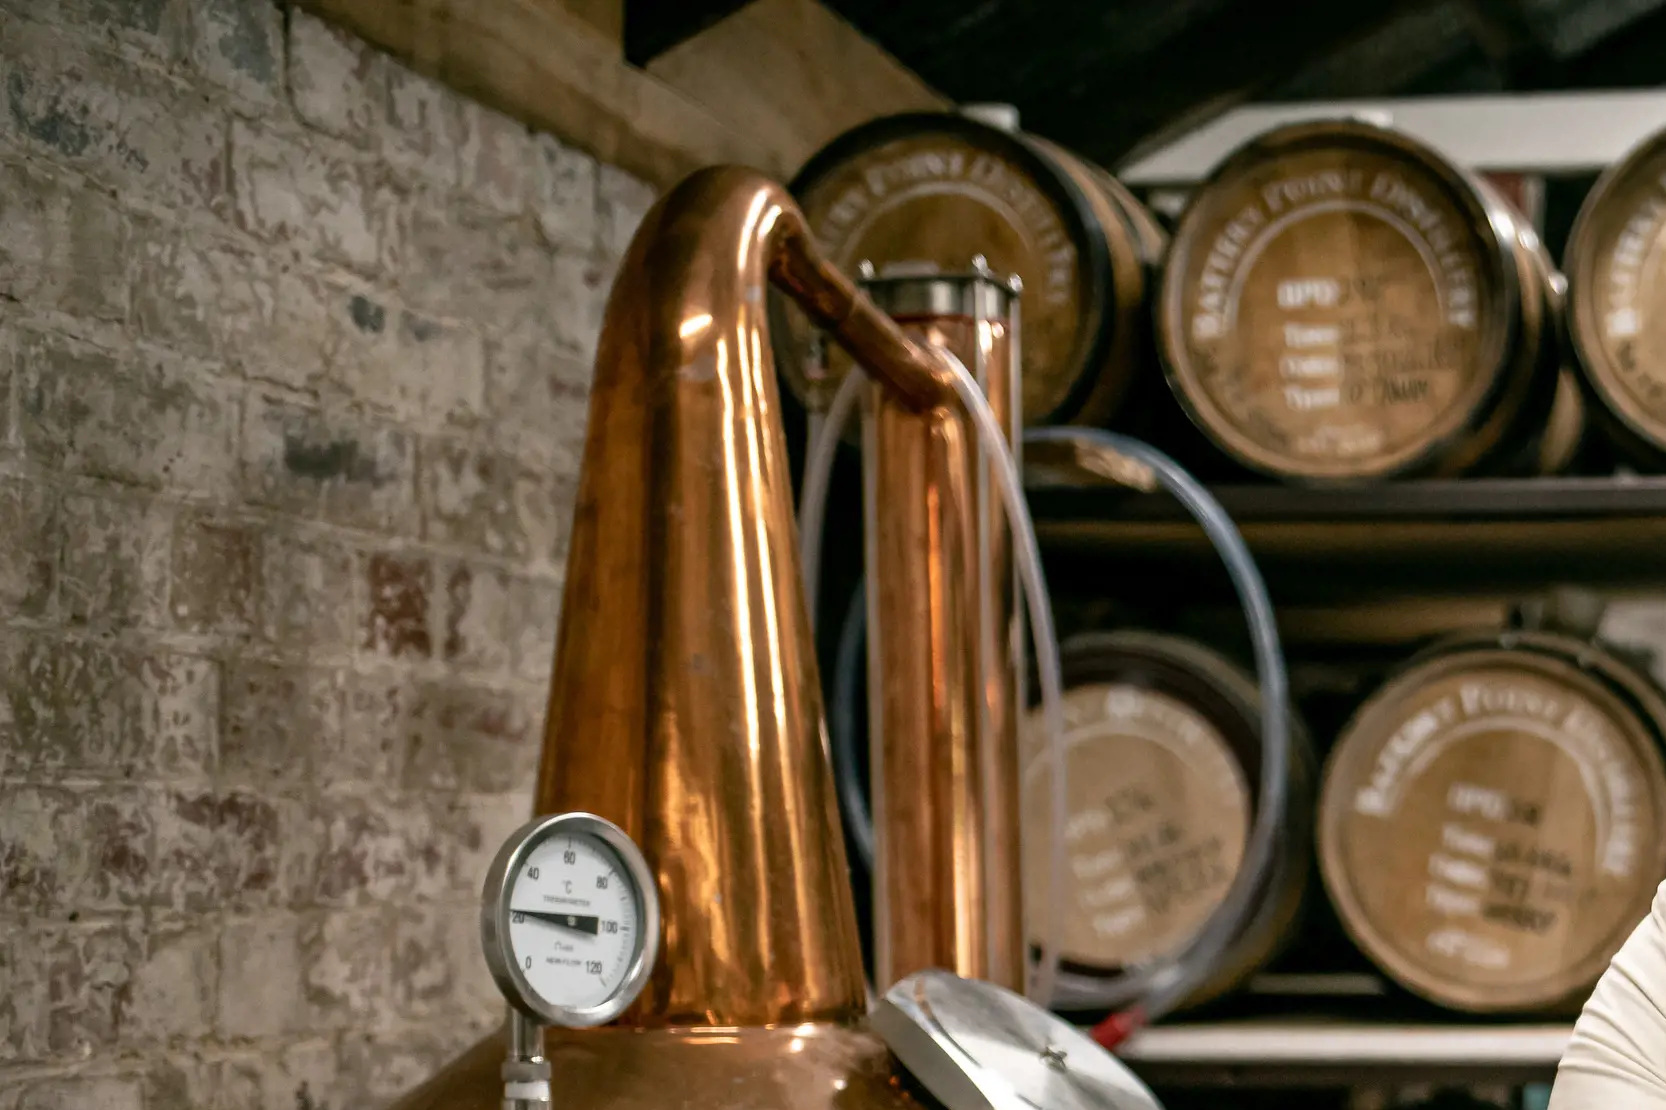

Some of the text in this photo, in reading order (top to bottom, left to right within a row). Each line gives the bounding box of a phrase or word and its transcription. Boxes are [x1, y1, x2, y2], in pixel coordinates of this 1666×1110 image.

[564, 851, 577, 866] 60
[527, 866, 540, 880] 40
[596, 876, 609, 889] 80
[512, 911, 525, 924] 20
[601, 921, 618, 934] 100
[524, 955, 533, 970] 0
[586, 961, 603, 974] 120
